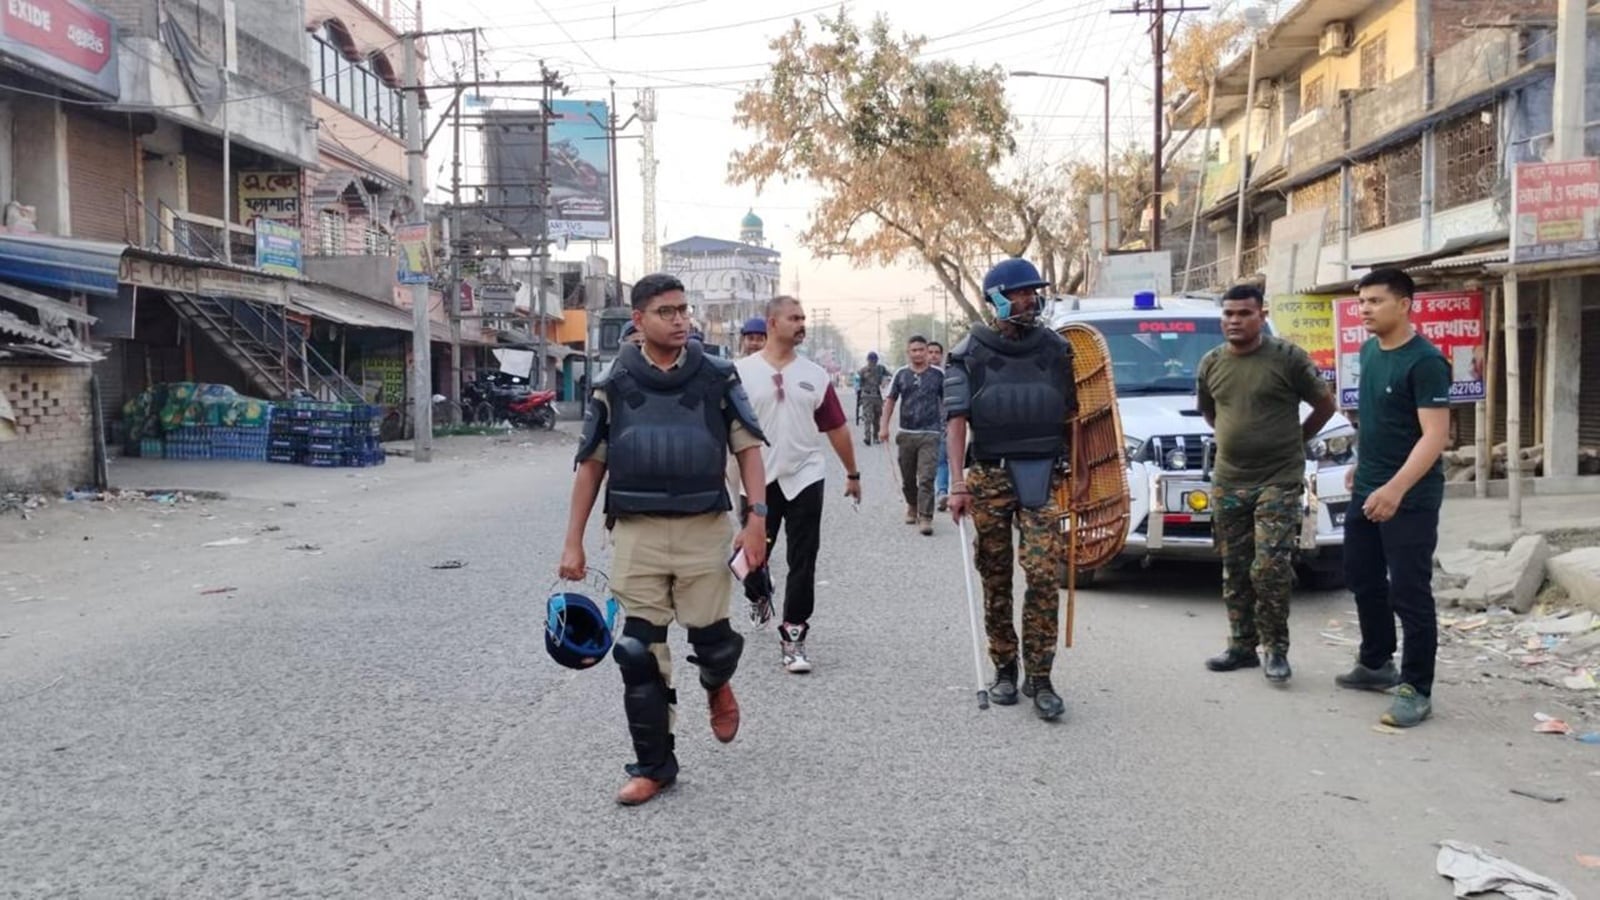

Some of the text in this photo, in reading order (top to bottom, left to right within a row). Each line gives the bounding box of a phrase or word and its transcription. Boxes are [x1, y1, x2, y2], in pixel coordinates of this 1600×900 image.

[8, 0, 51, 32] EXIDE
[150, 263, 194, 291] CARE
[1426, 297, 1471, 312] রকমের
[1139, 322, 1195, 332] POLICE
[1421, 319, 1480, 338] দরখাস্ত
